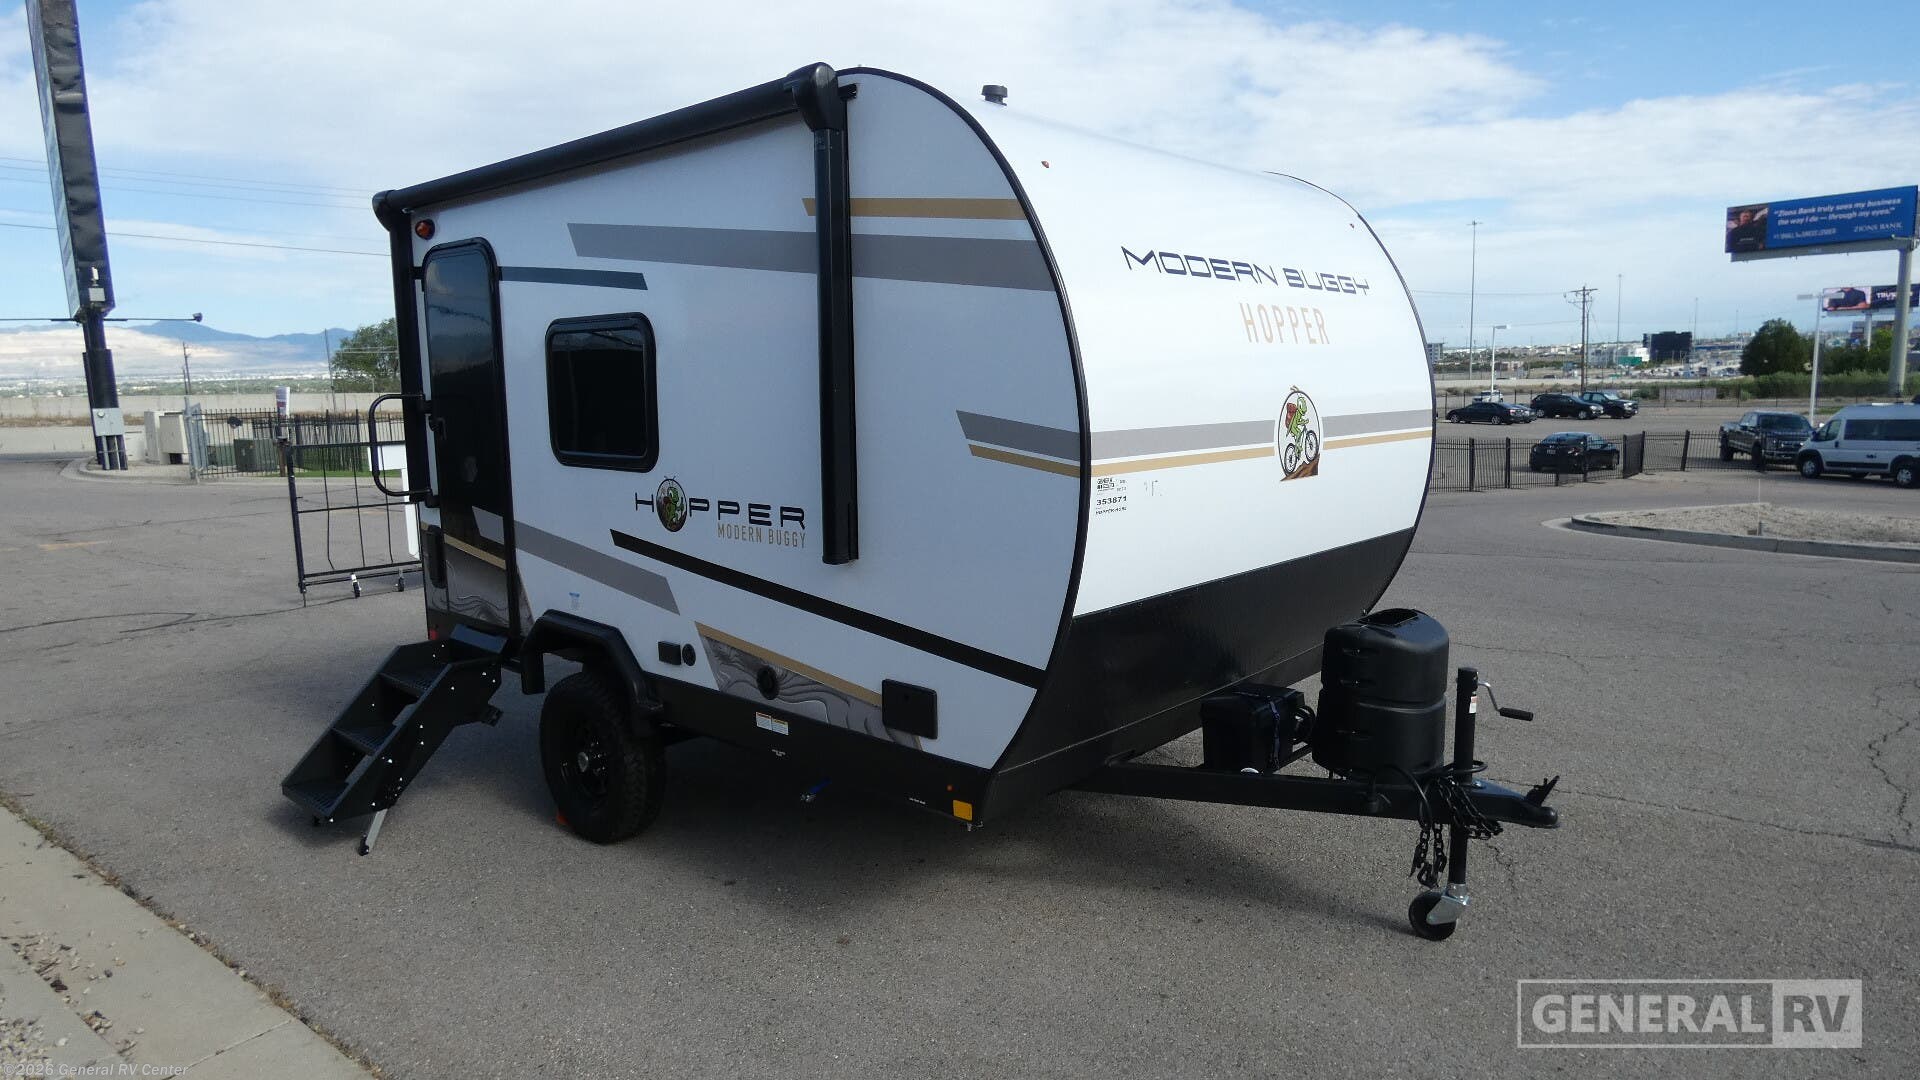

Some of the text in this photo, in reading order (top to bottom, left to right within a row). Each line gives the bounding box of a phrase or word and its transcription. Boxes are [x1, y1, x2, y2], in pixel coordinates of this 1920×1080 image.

[1798, 207, 1816, 215] Bank
[1817, 204, 1834, 213] truly
[1867, 197, 1901, 207] business
[1777, 218, 1789, 226] the
[1790, 217, 1805, 226] way
[1809, 214, 1819, 223] do
[1828, 210, 1857, 221] through
[1858, 209, 1871, 218] my
[1854, 221, 1902, 233] ZIONS BANK
[1120, 246, 1370, 296] MODERN BUGGY
[1239, 302, 1330, 345] HOPPER
[1096, 496, 1127, 506] 353871
[717, 522, 806, 549] MODERN BUGGY
